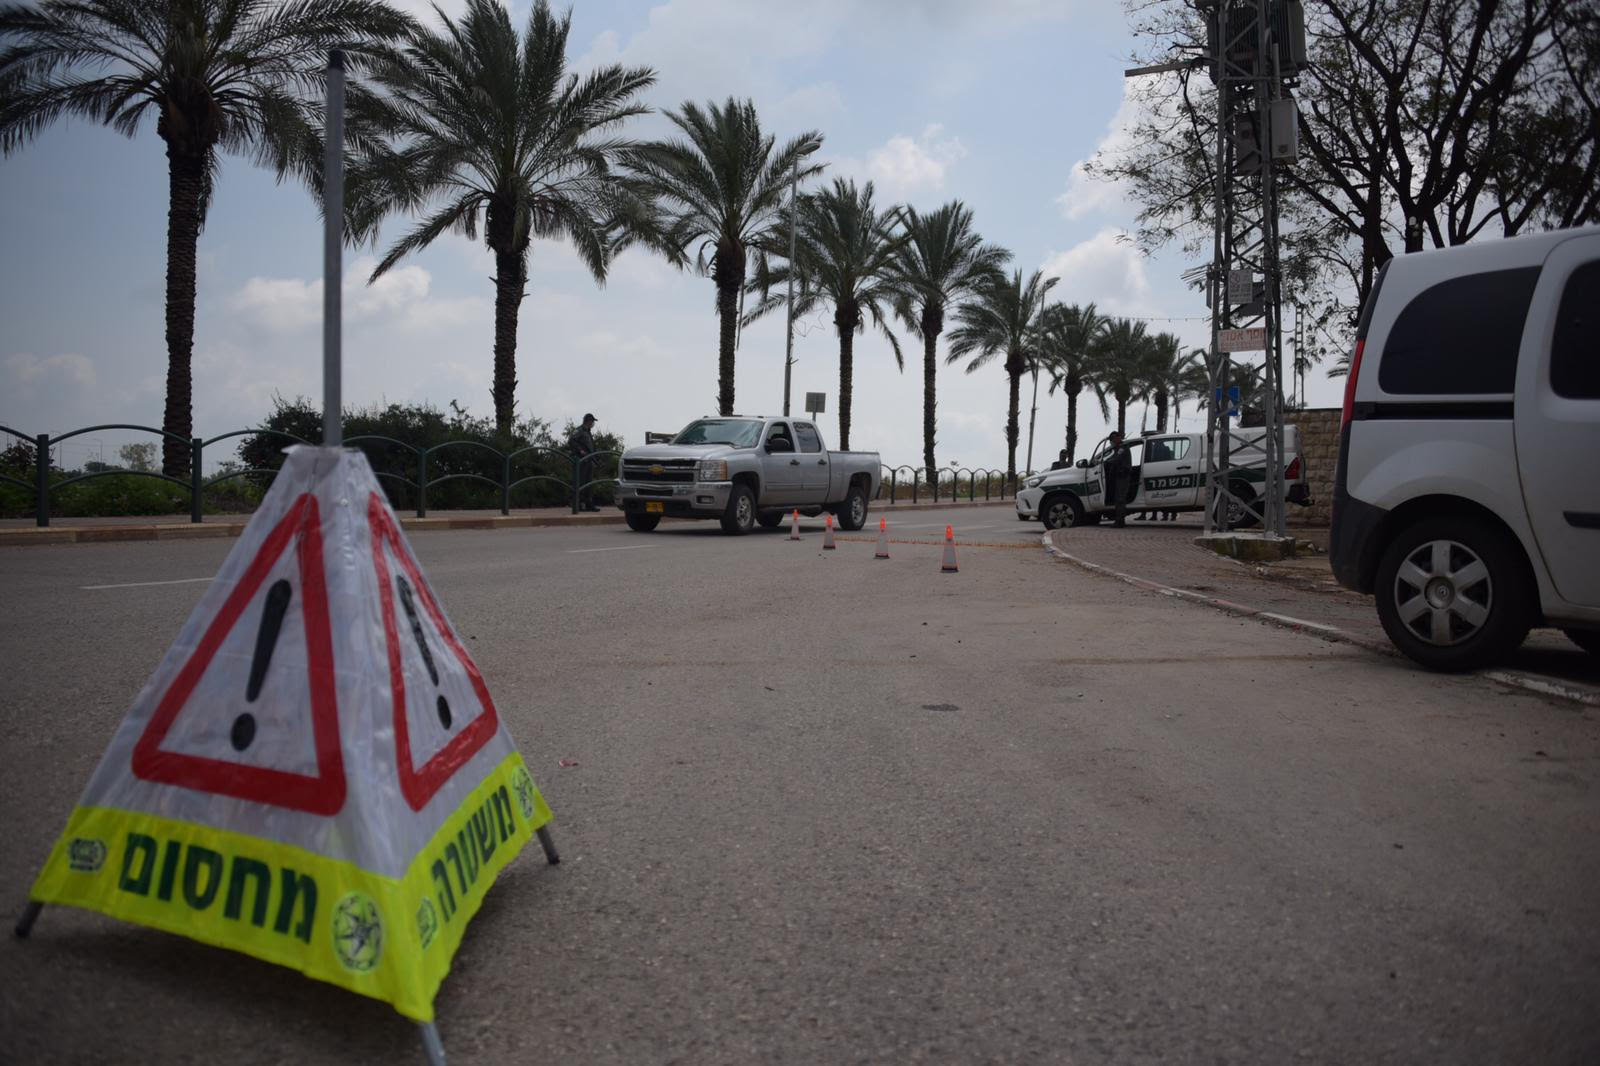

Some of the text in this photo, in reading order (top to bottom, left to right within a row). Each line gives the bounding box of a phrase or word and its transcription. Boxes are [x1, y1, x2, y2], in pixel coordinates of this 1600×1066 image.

[1149, 476, 1190, 488] משמר
[118, 832, 318, 944] מחסום
[432, 785, 516, 923] משטרה
